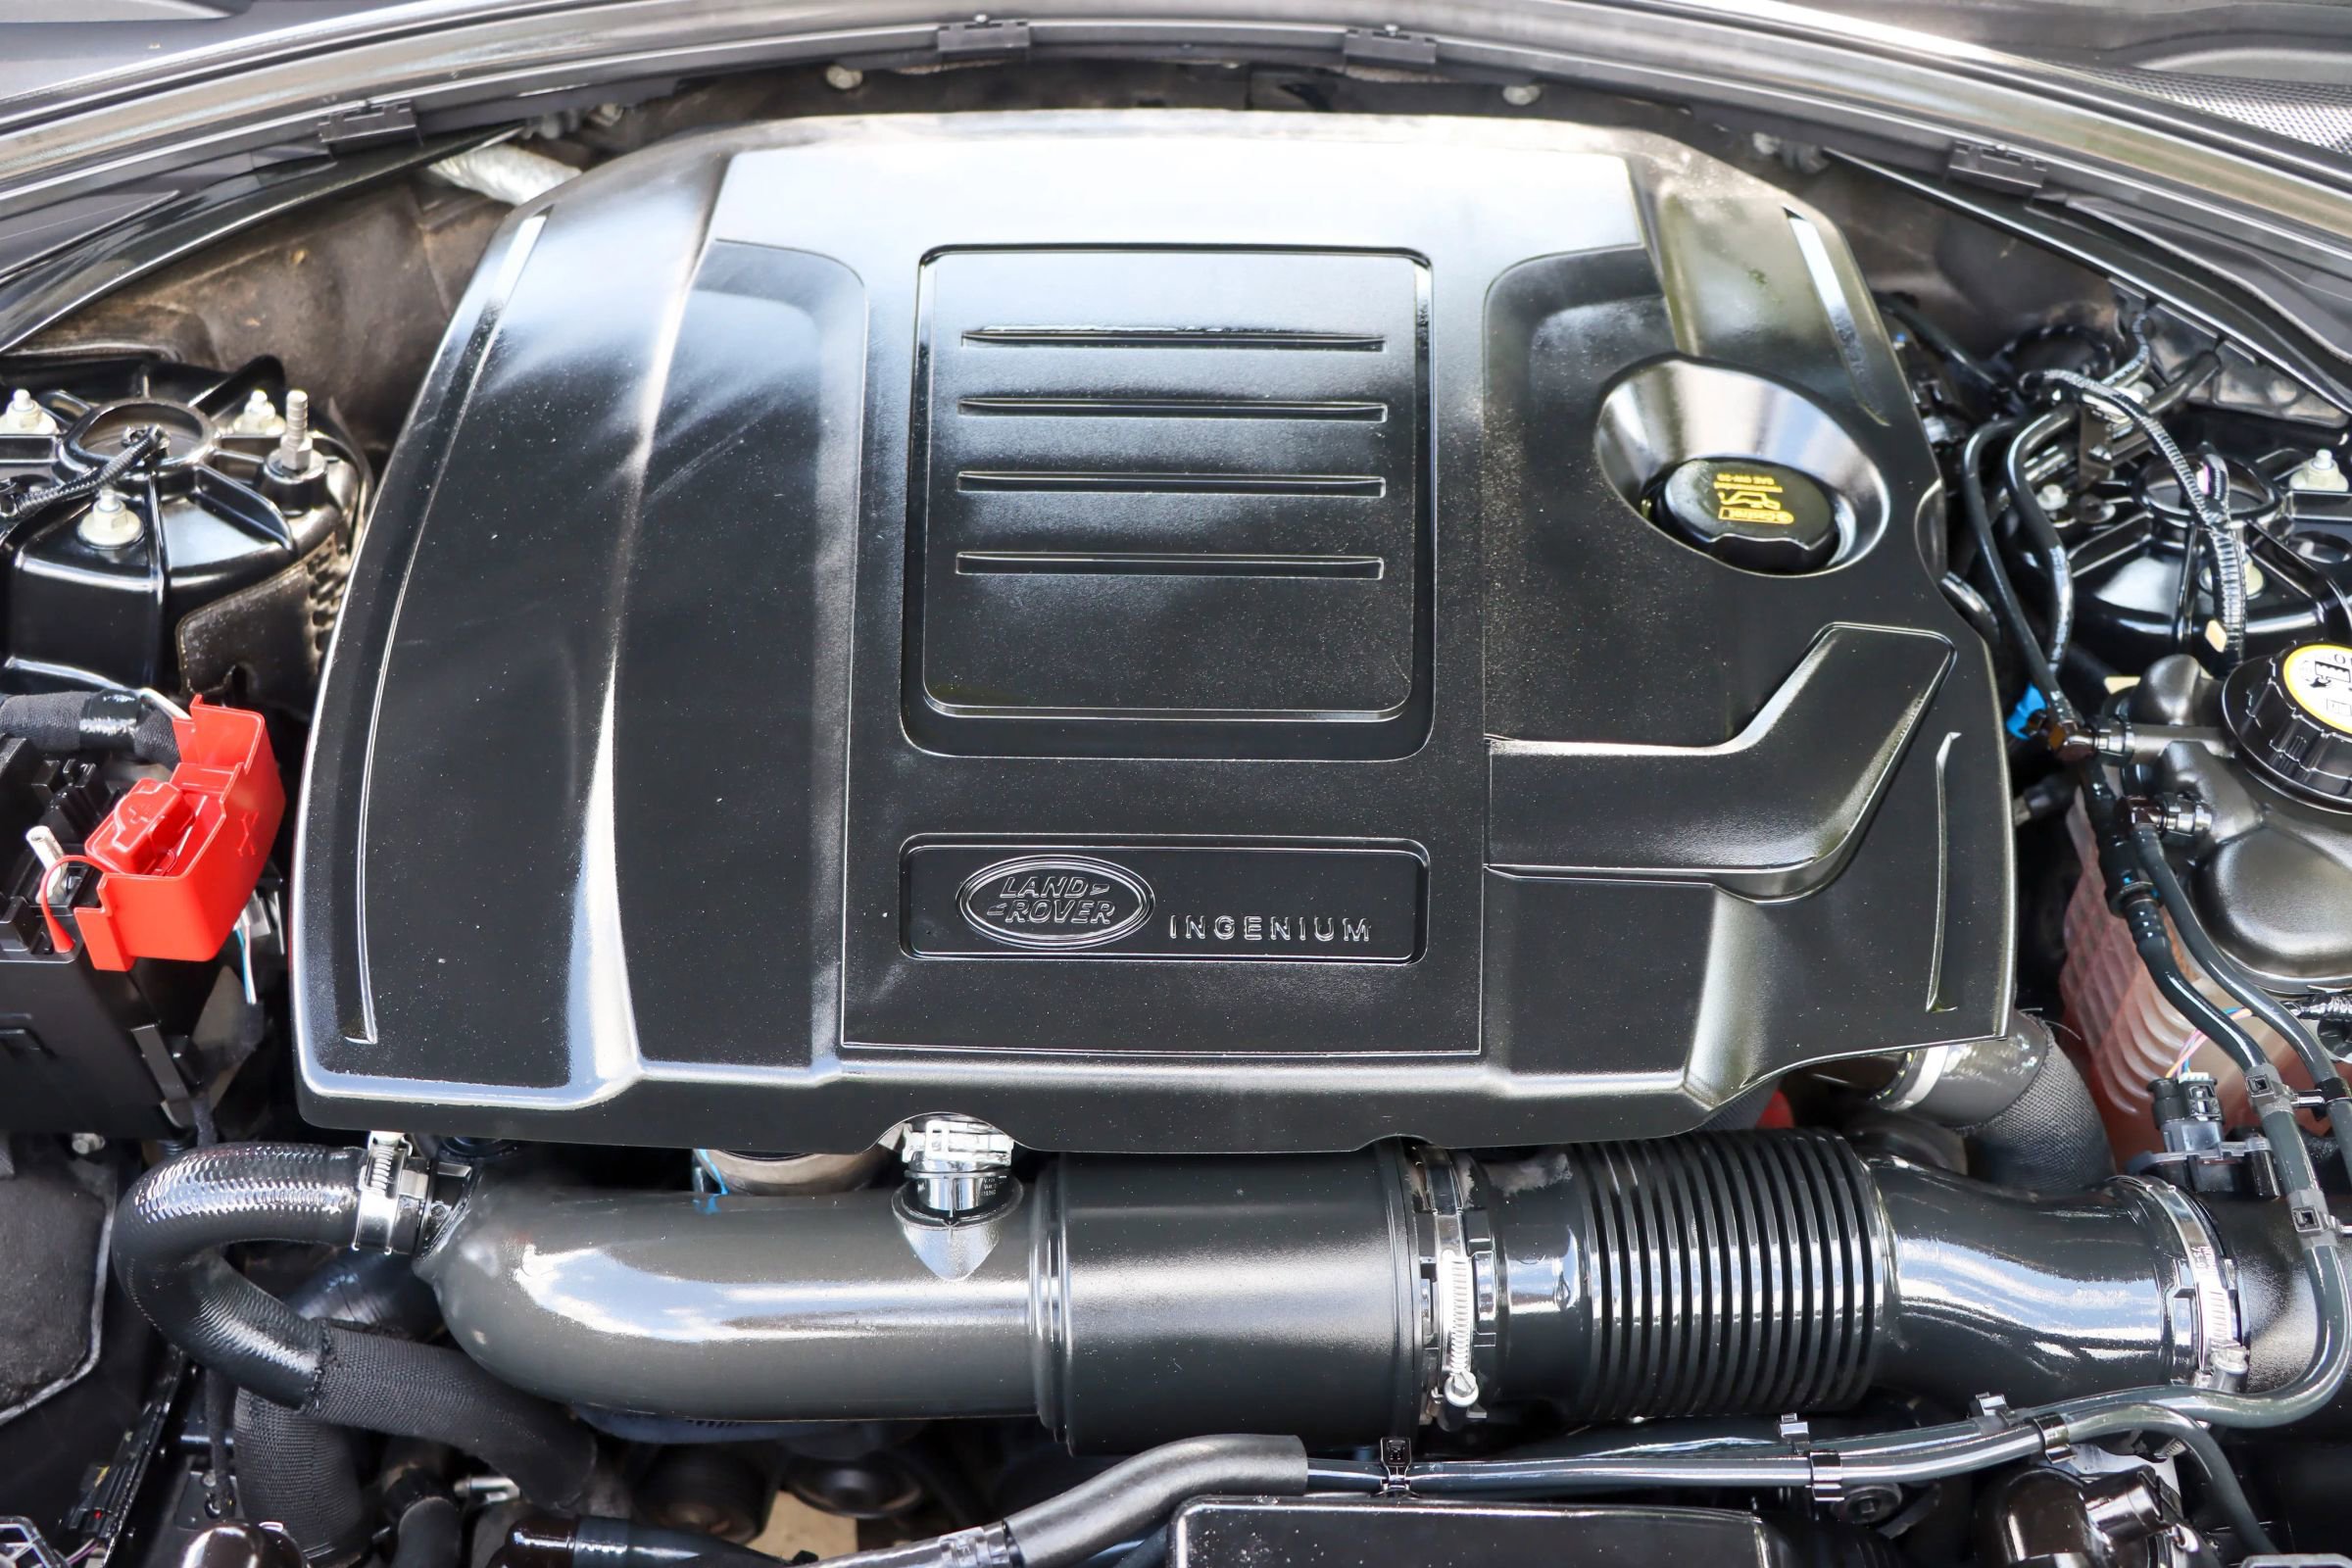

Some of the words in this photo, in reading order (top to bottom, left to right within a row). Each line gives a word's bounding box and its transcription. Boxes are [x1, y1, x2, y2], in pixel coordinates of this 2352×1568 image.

[999, 876, 1090, 900] LAND
[1004, 900, 1116, 925] ROVER
[1169, 914, 1371, 942] INGENIUM
